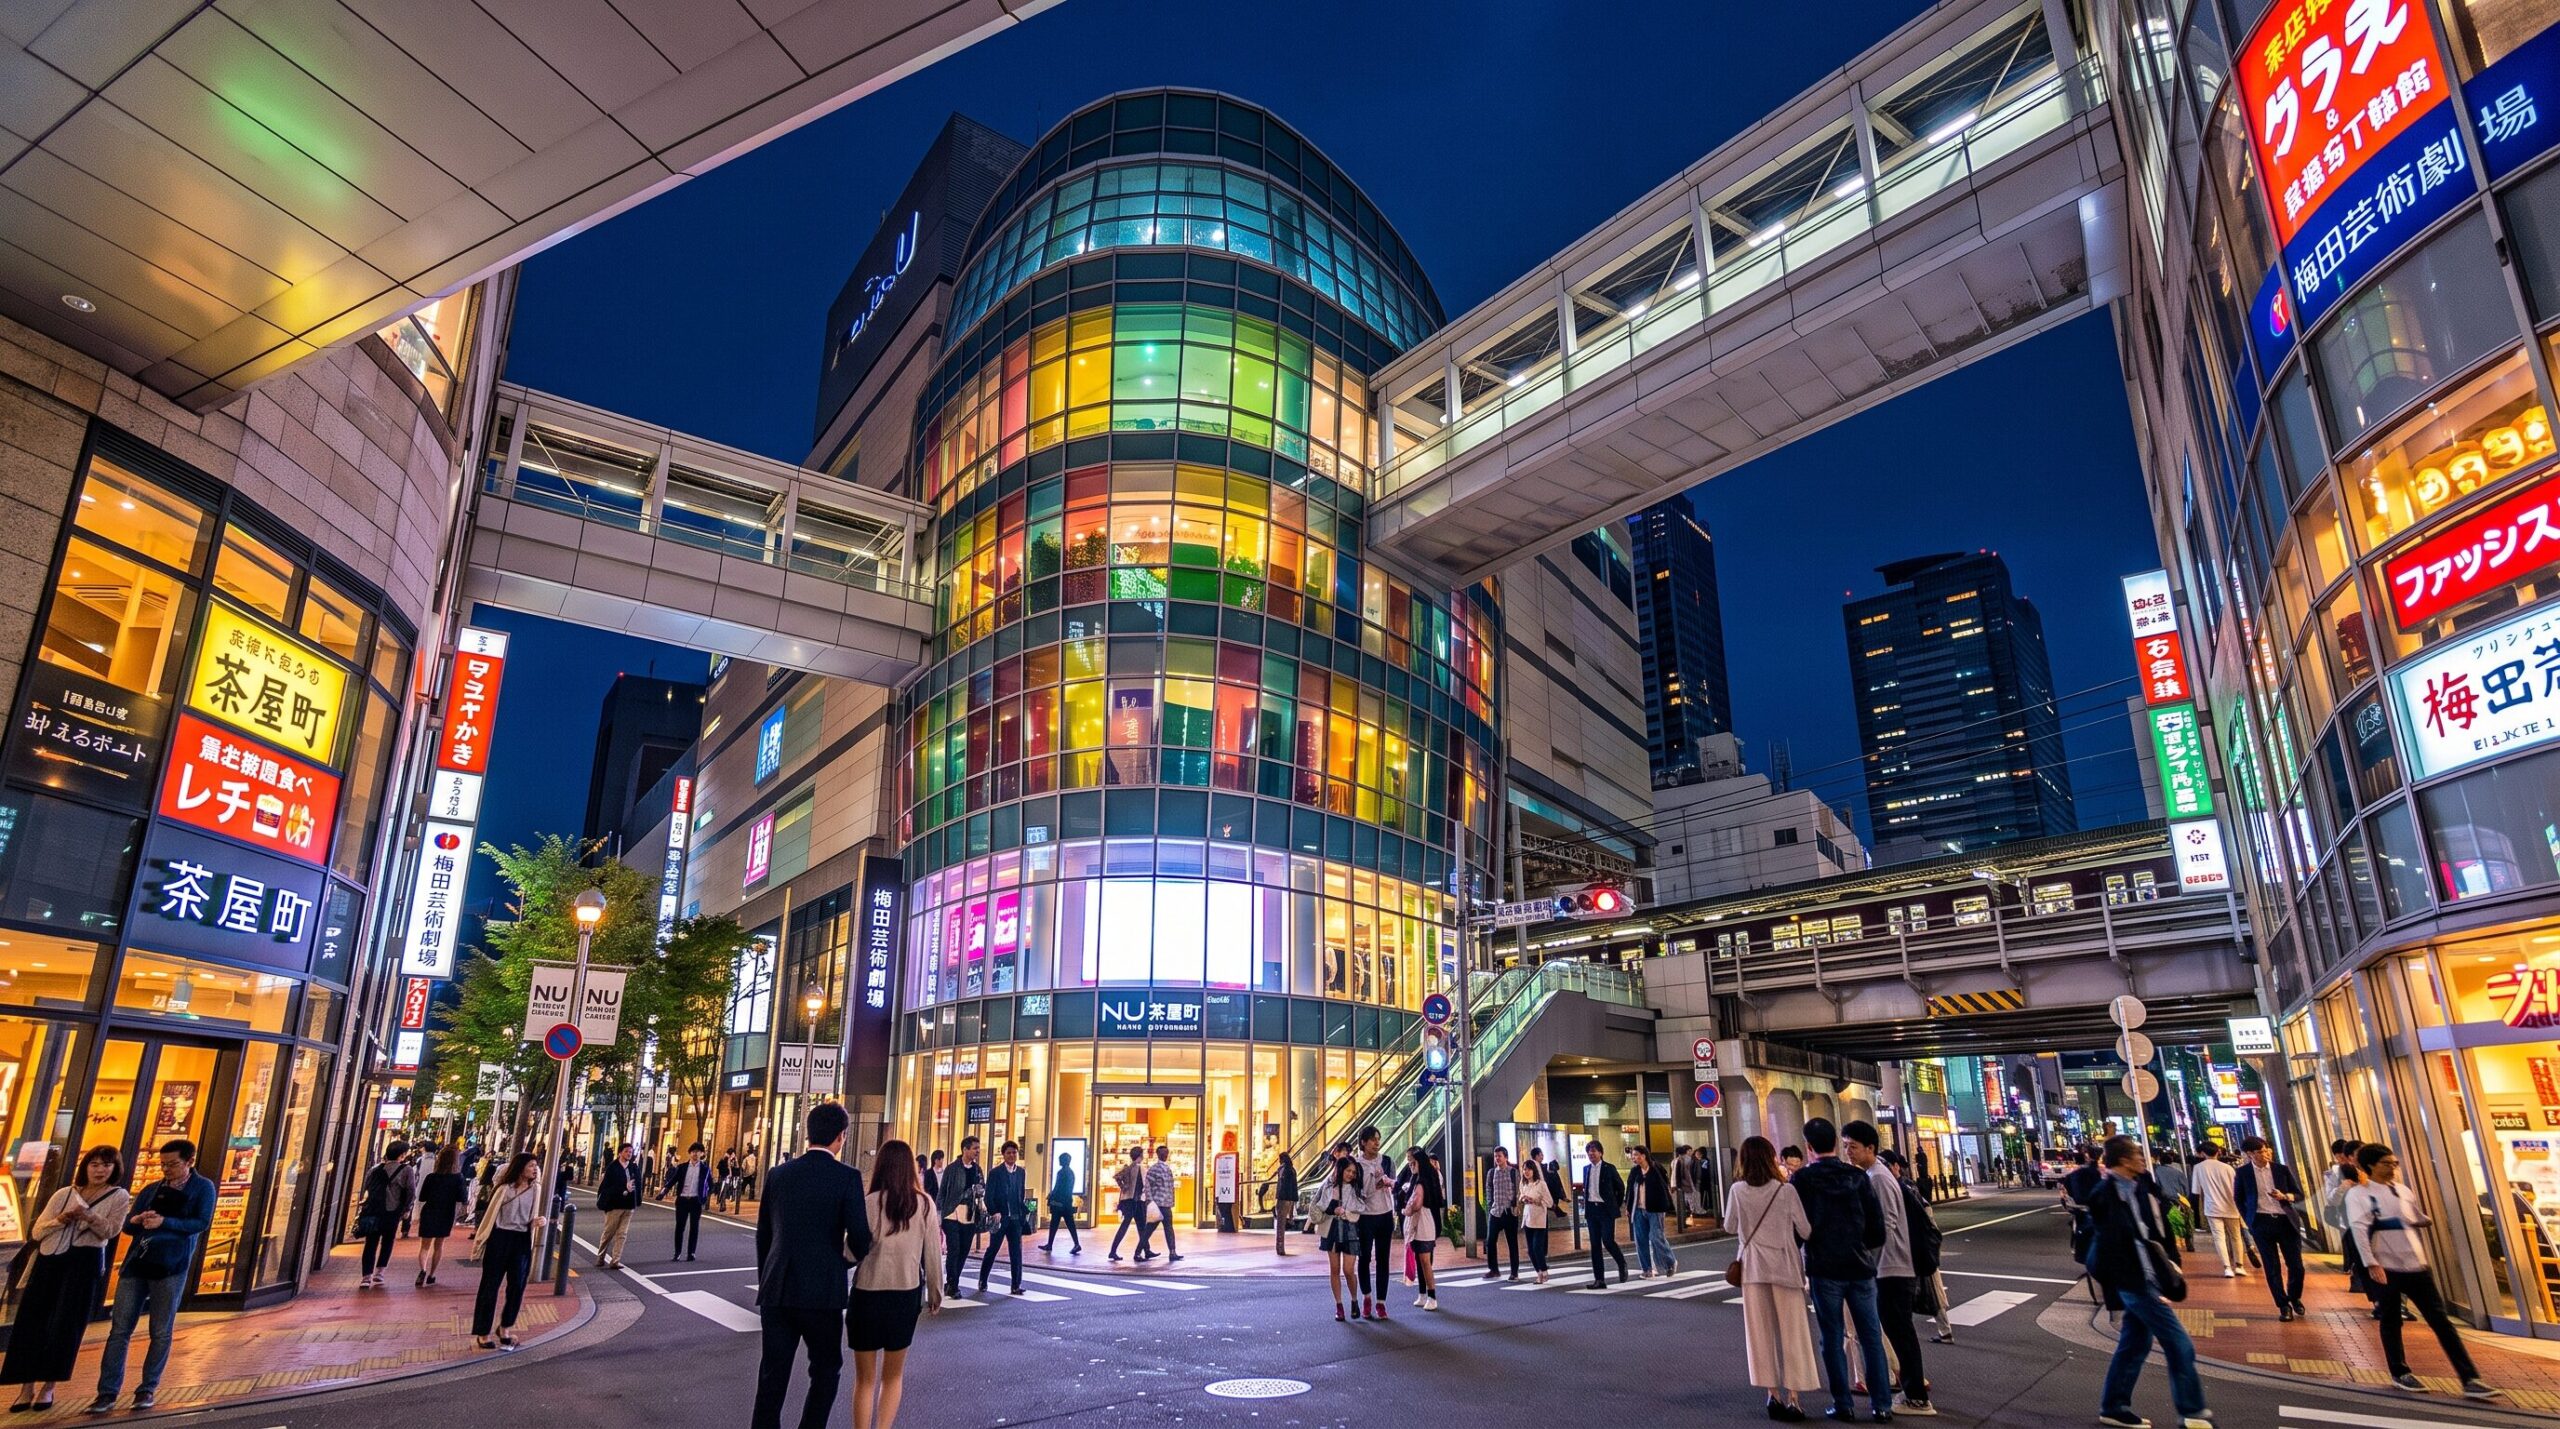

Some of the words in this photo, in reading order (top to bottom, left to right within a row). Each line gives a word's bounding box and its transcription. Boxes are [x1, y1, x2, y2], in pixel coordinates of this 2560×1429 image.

[2293, 85, 2538, 303] 梅田芸術劇場
[2395, 497, 2560, 608] ファッシス
[205, 653, 327, 749] 茶屋町
[161, 859, 313, 943] 茶屋町
[417, 854, 454, 967] 梅田芸術劇場
[533, 985, 568, 1002] NU
[587, 989, 619, 1006] NU
[1102, 1001, 1146, 1022] NU
[782, 1057, 803, 1068] NU
[814, 1059, 834, 1070] NU
